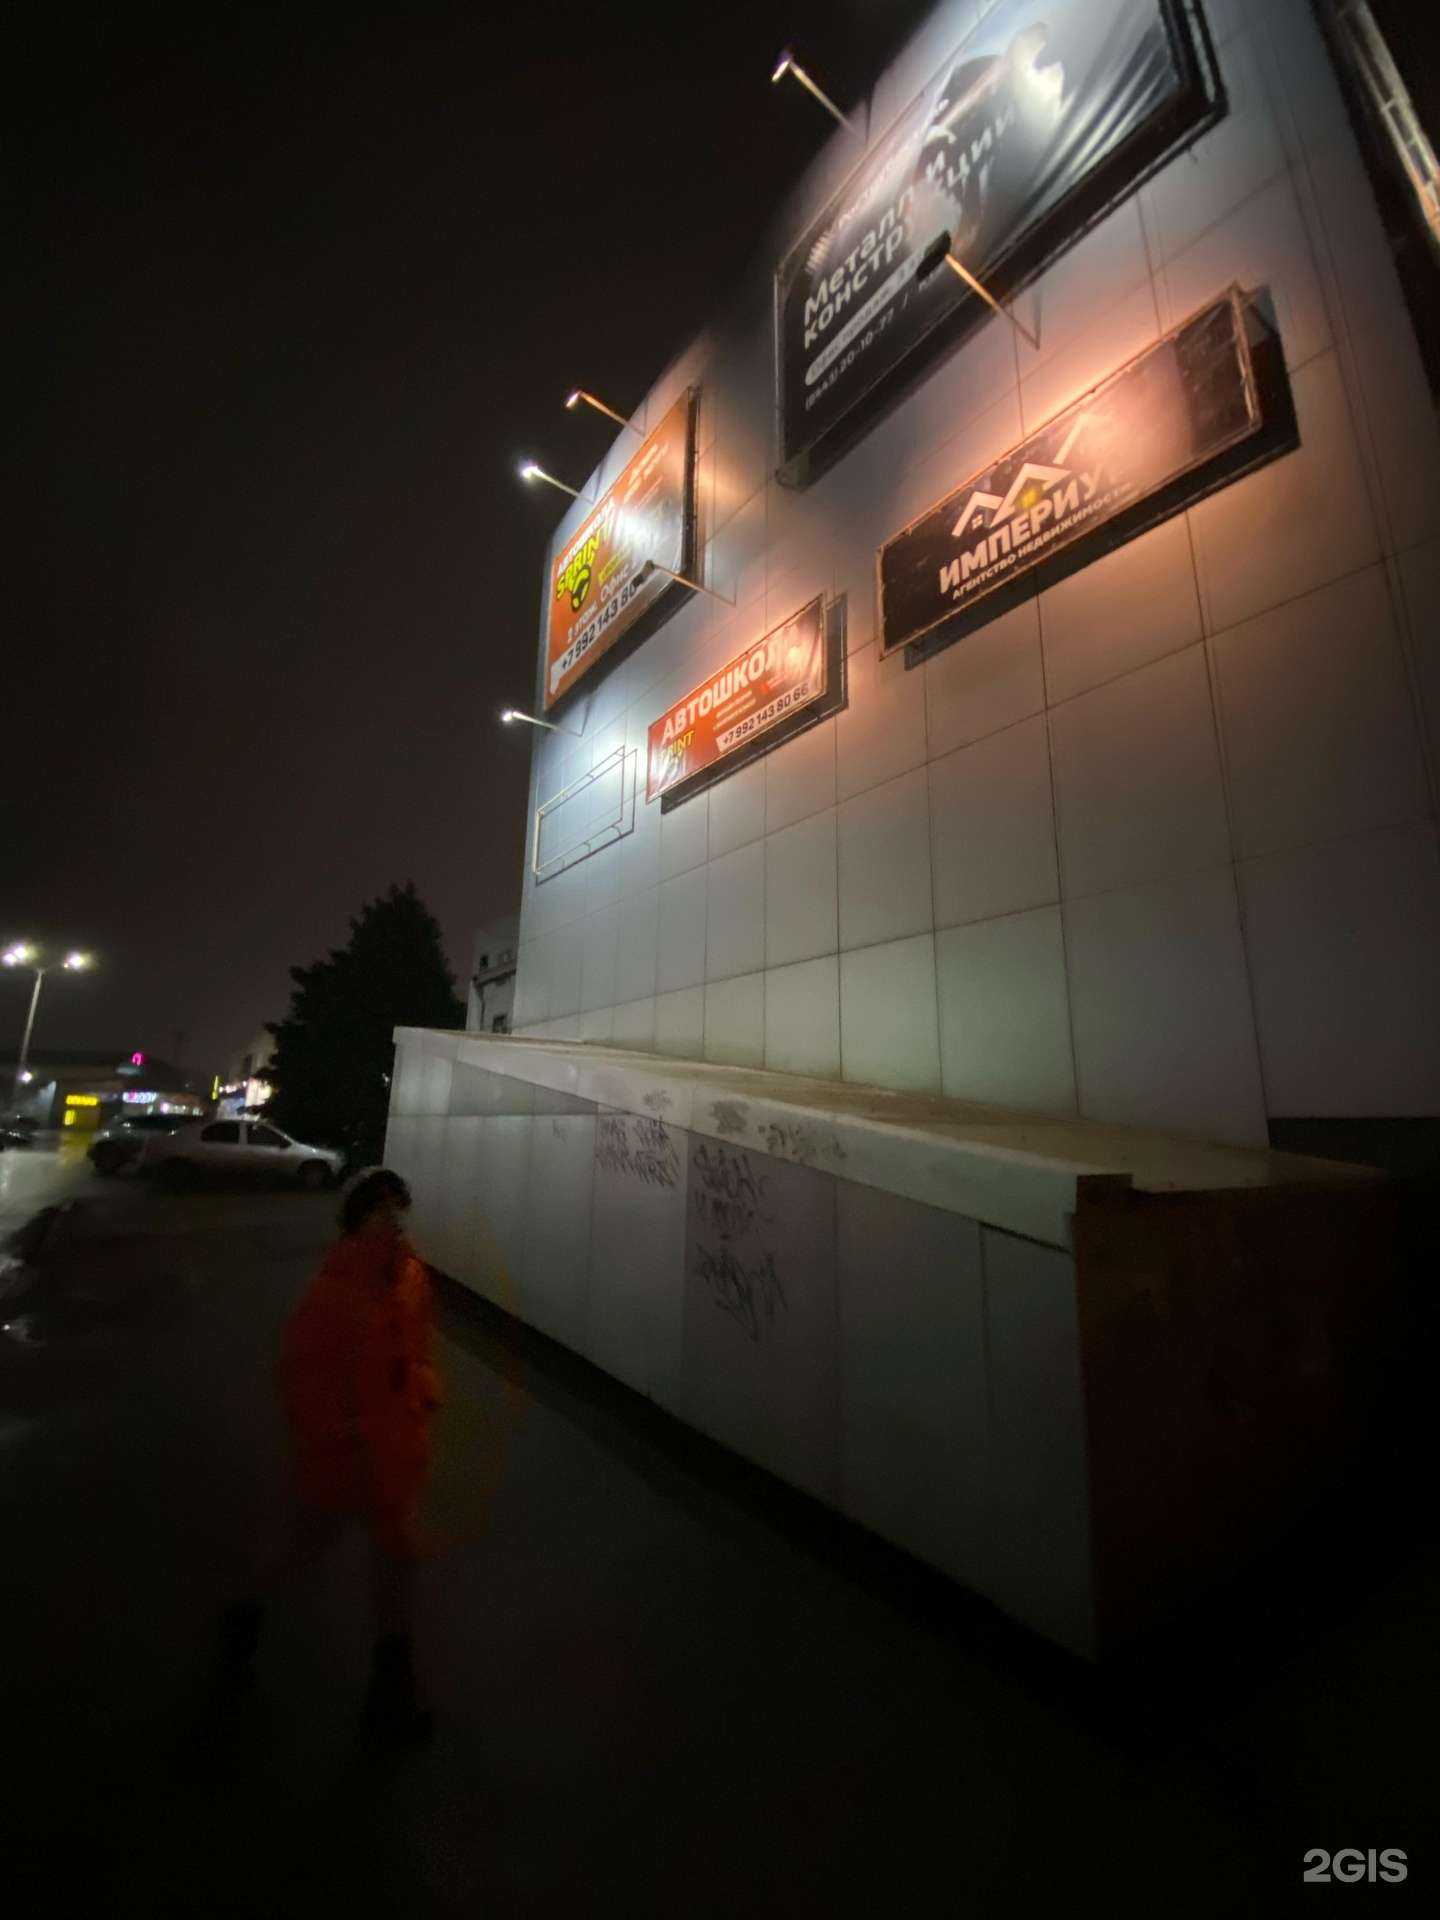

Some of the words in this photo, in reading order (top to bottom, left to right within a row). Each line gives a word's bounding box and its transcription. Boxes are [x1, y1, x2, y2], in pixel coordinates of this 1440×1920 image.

[804, 105, 1014, 350] констрции
[952, 554, 1016, 600] АГЕНТСТВО
[575, 626, 595, 659] 992
[597, 601, 619, 634] 143
[723, 731, 735, 745] +7
[736, 718, 755, 739] 992
[756, 705, 775, 724] 143
[776, 696, 791, 712] 80
[792, 683, 810, 702] 66
